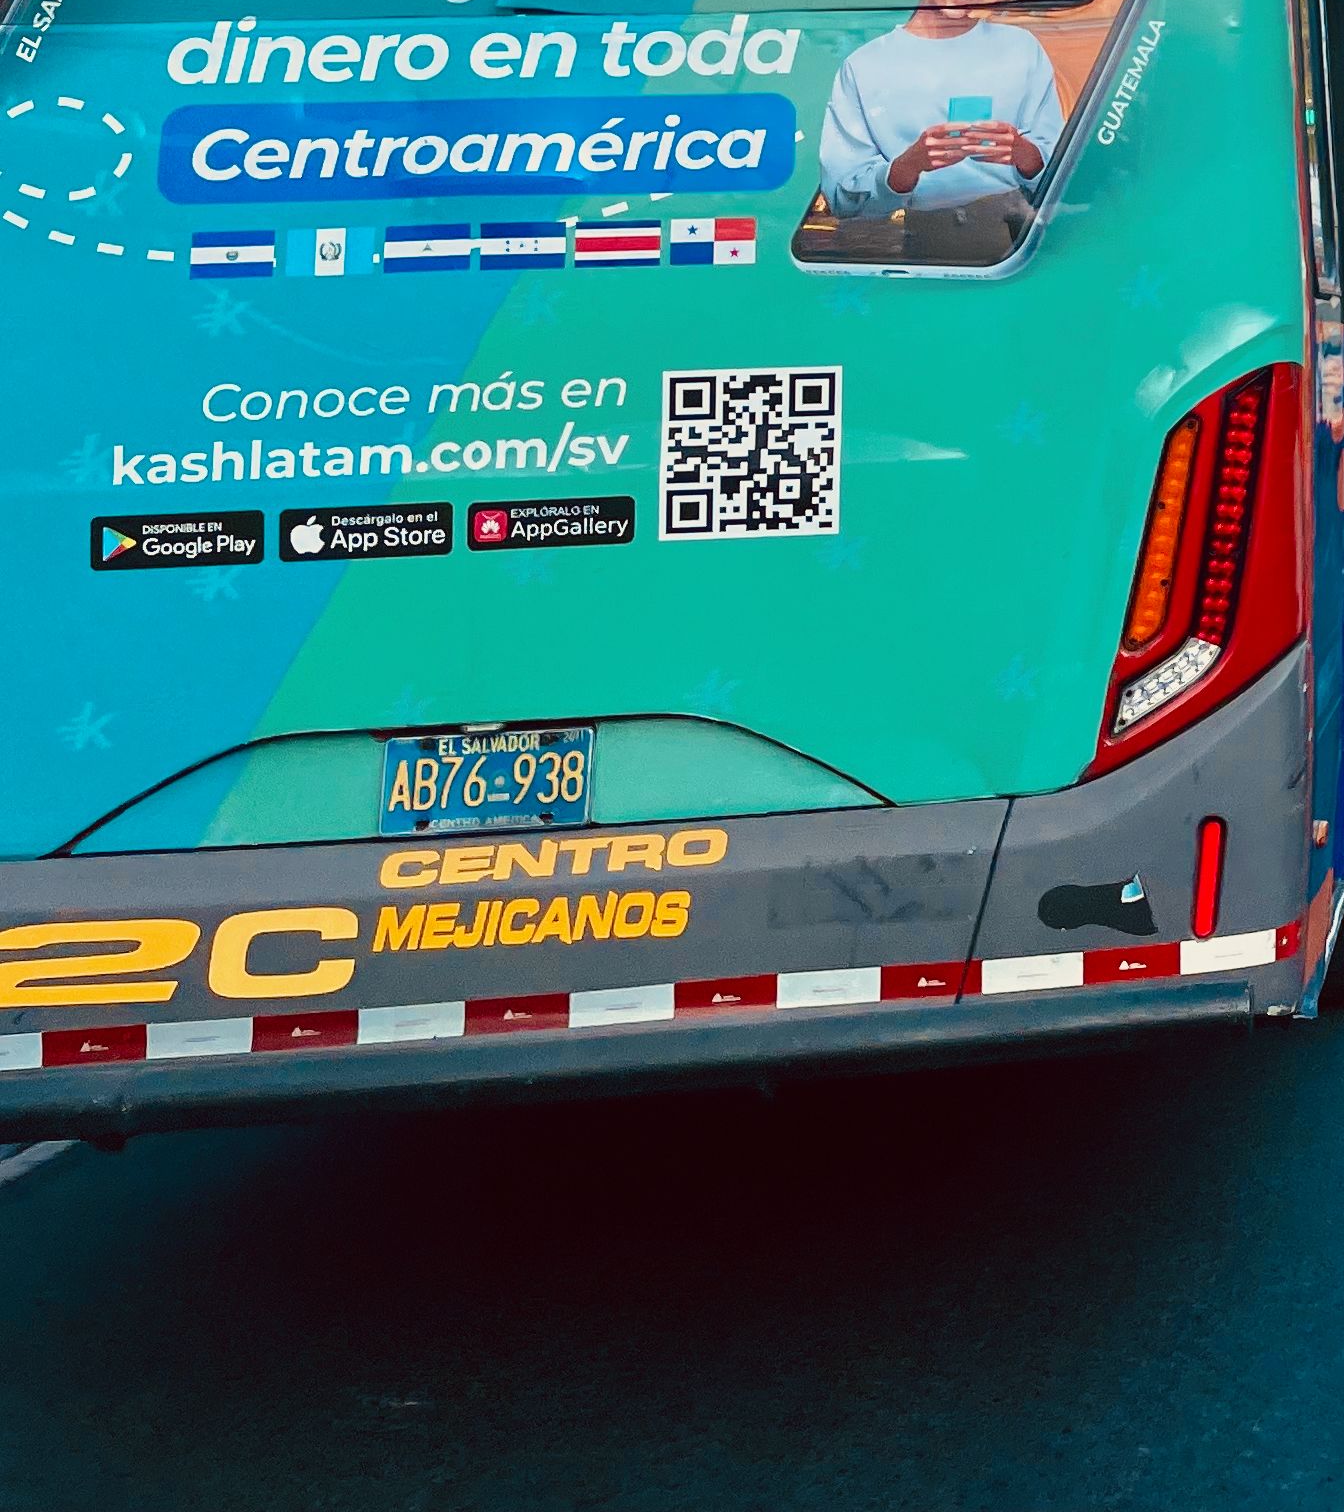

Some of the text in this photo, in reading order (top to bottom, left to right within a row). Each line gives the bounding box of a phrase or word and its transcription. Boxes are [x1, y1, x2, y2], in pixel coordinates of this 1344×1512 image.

[15, 35, 43, 63] EL
[166, 13, 801, 86] dinero en toda
[1097, 20, 1167, 146] GUATEMALA
[191, 114, 766, 182] Centroamérica
[201, 372, 627, 423] Conoce más en
[112, 422, 630, 488] kashlatam.com/sv
[331, 511, 438, 528] Descárgalo en el
[582, 505, 600, 516] EN
[142, 522, 223, 535] DISPONIBLE EN
[330, 526, 446, 552] App Store
[510, 517, 629, 541] AppGallery
[142, 536, 256, 559] Google Play
[438, 738, 457, 756] EL
[462, 734, 541, 755] SALVADOR
[380, 828, 729, 889] CENTRO
[372, 890, 692, 953] MEJICANOS
